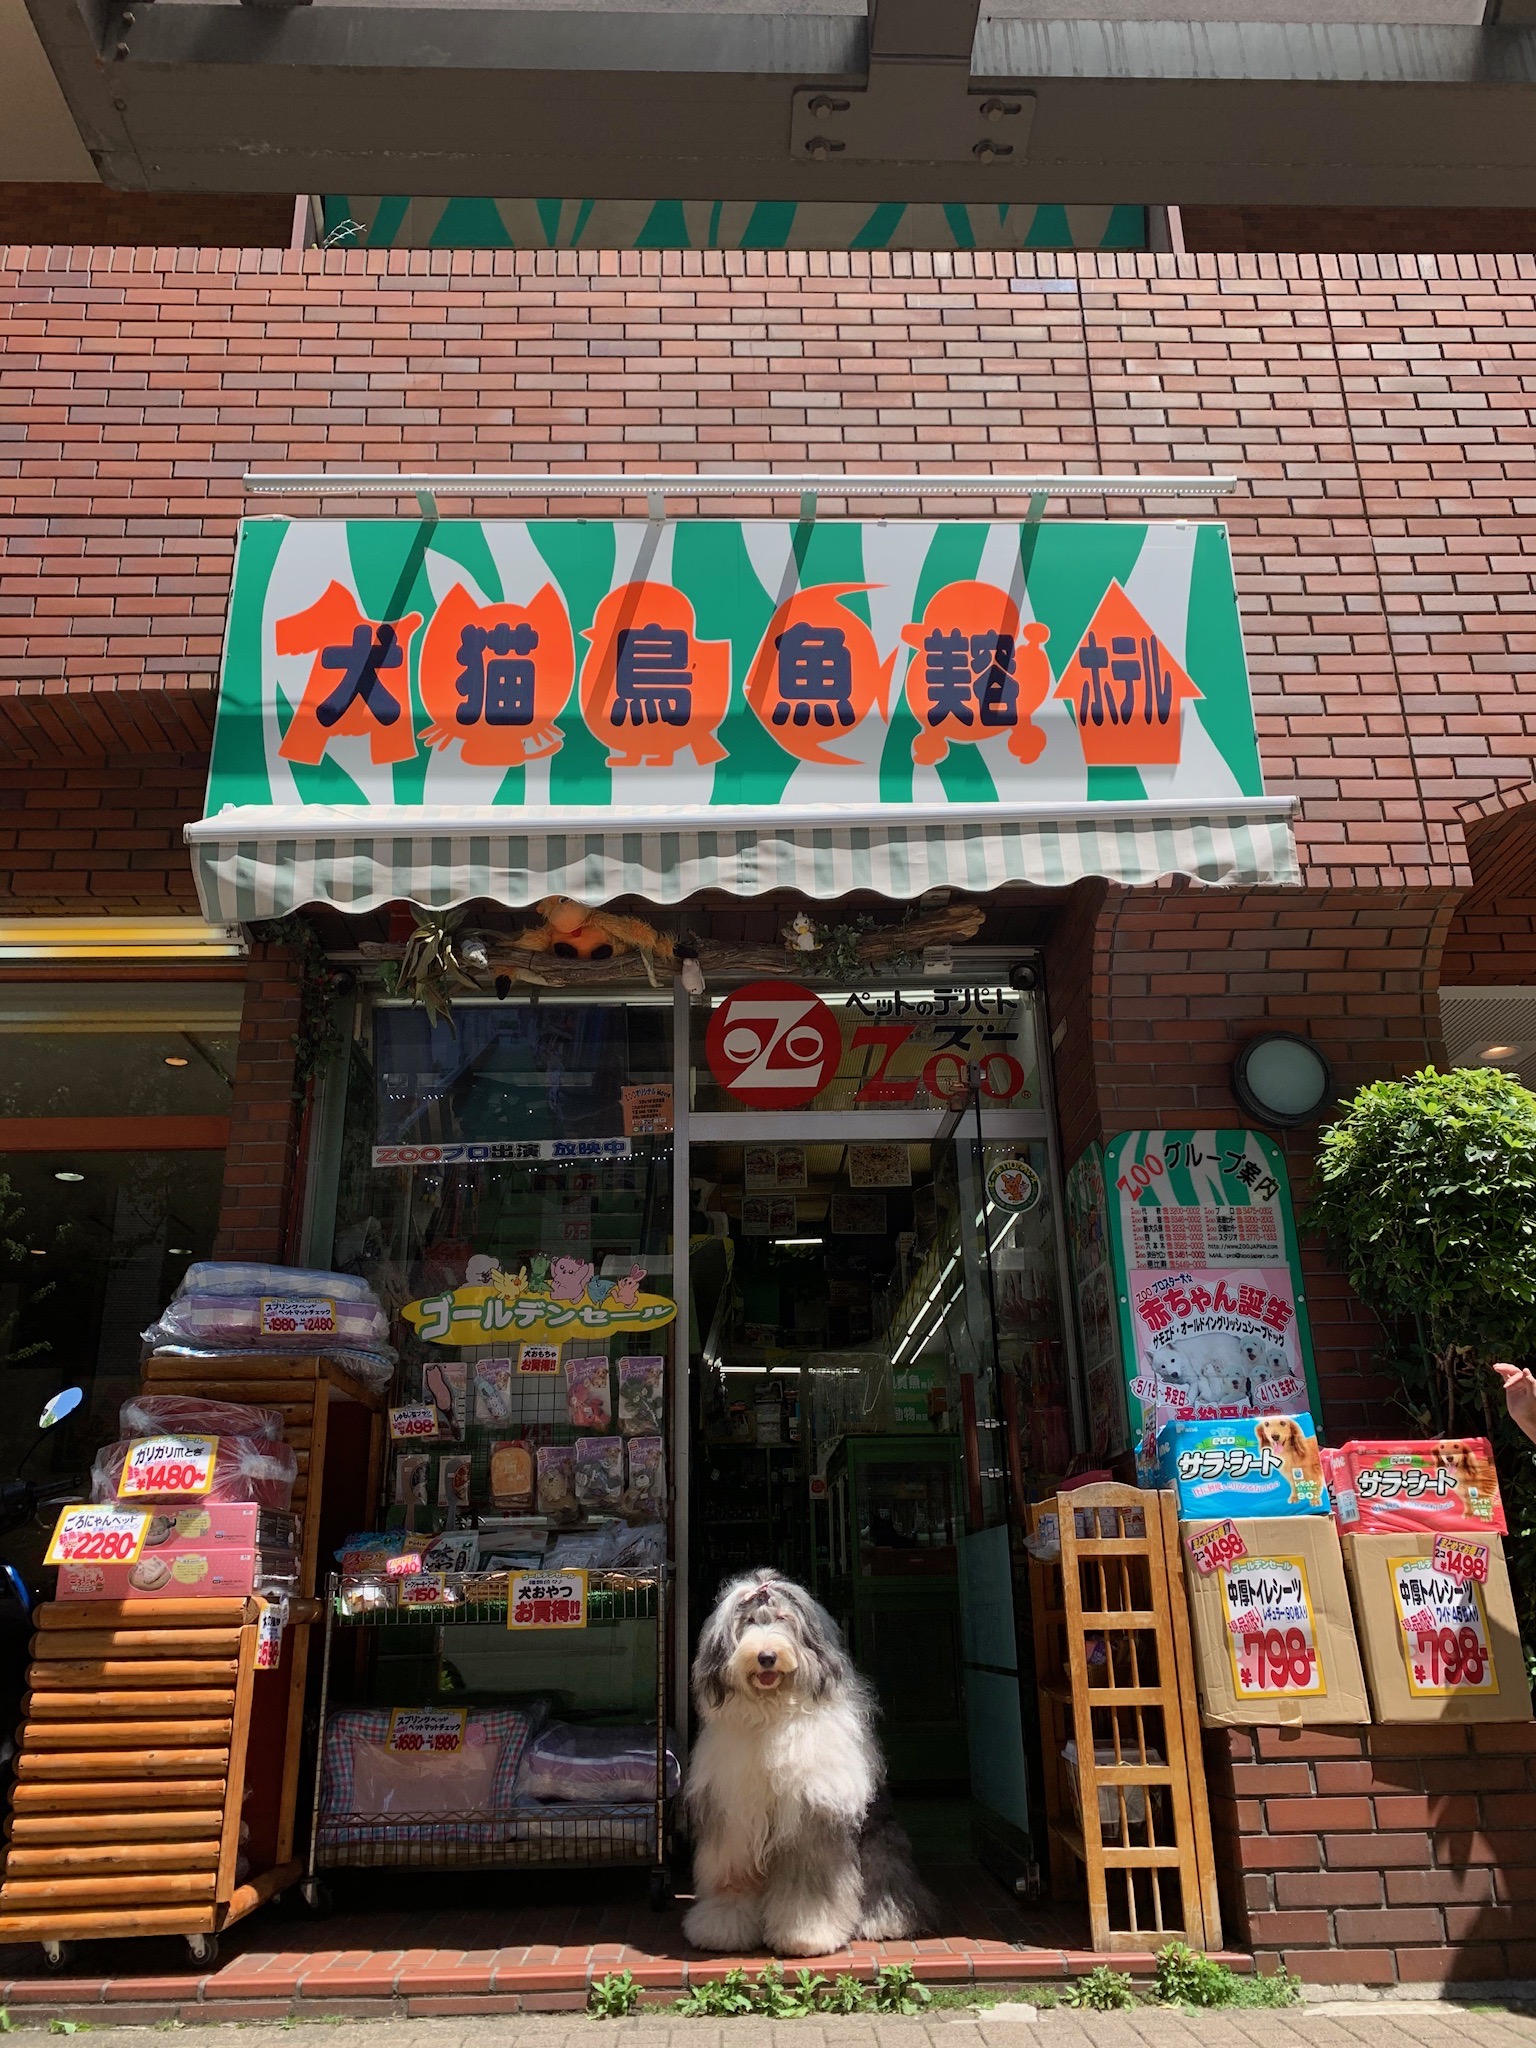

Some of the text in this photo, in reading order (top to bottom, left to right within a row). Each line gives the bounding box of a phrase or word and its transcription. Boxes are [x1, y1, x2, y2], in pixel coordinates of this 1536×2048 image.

[317, 622, 1172, 728] 犬 猫 鳥 魚 美容 ホテル
[846, 988, 1017, 1017] ペットのデパート
[932, 1025, 1019, 1051] ズー
[376, 1140, 625, 1164] ZOOプロ出演 放映中
[421, 1291, 673, 1341] ゴールデンセール
[1138, 1281, 1294, 1332] 赤ちゃん誕生
[1261, 1377, 1298, 1402] 4/13 生まれ
[1212, 1436, 1235, 1446] eco
[135, 1446, 204, 1466] ガリガリ爪とぎ
[1178, 1448, 1282, 1480] サラ・シート
[1389, 1456, 1412, 1465] eco
[1358, 1469, 1457, 1498] サラ・シート
[64, 1514, 138, 1532] ごろにゃんベッド
[522, 1571, 575, 1581] ゴールデンセール
[1232, 1559, 1293, 1575] ゴールデンセール
[518, 1586, 573, 1599] 犬おやつ
[1227, 1578, 1303, 1607] 中厚トイレシーツ
[1400, 1579, 1473, 1606] 中厚トイレシーツ
[514, 1600, 581, 1623] お買得!!
